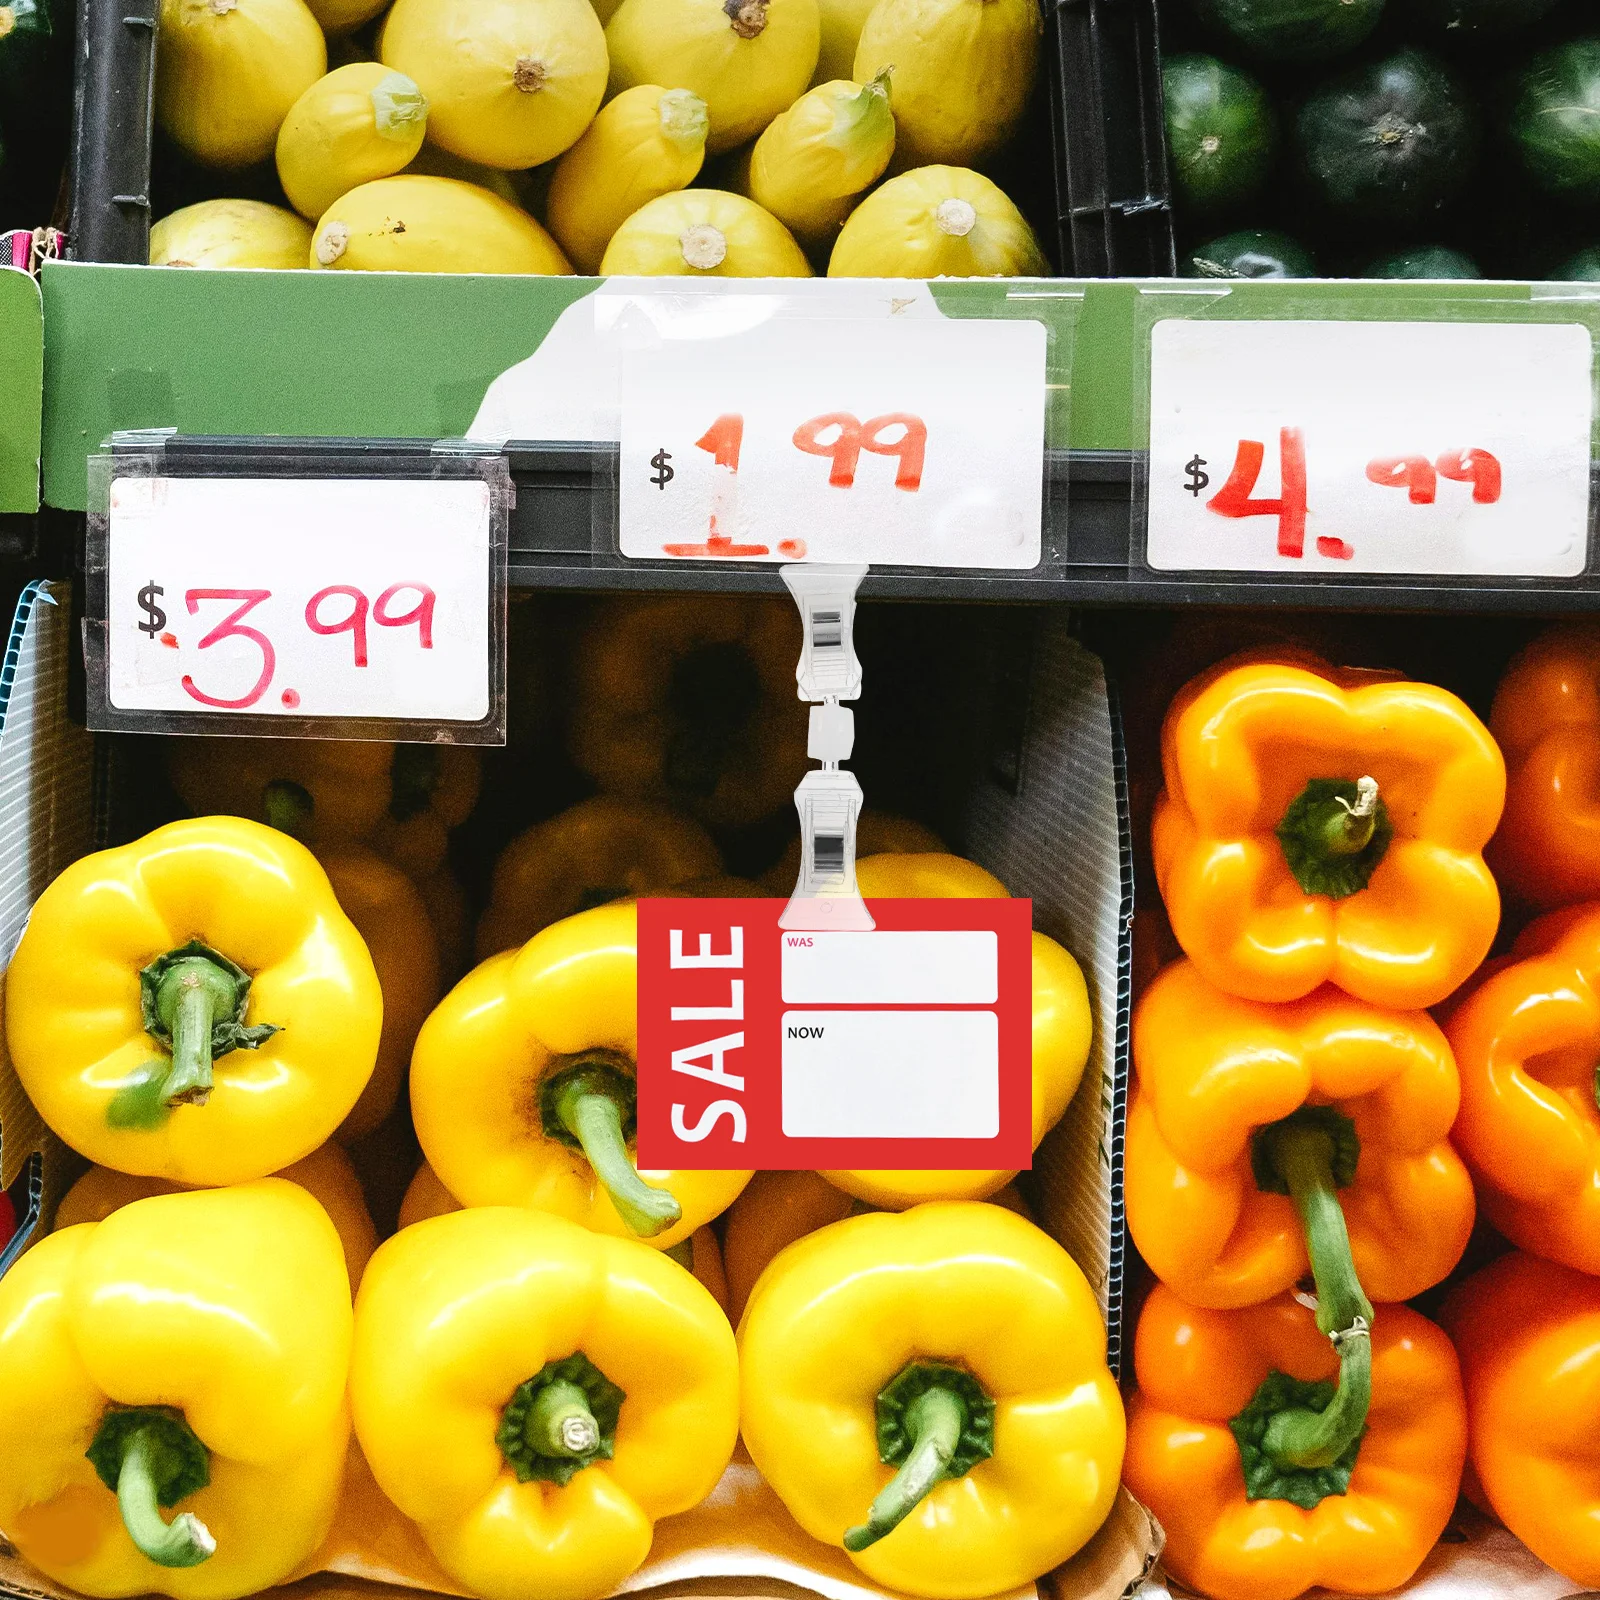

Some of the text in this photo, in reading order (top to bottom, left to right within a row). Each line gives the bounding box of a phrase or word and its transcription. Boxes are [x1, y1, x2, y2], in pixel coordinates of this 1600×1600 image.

[787, 937, 814, 947] WAS
[669, 926, 747, 1143] SALE
[787, 1027, 825, 1039] NOW
